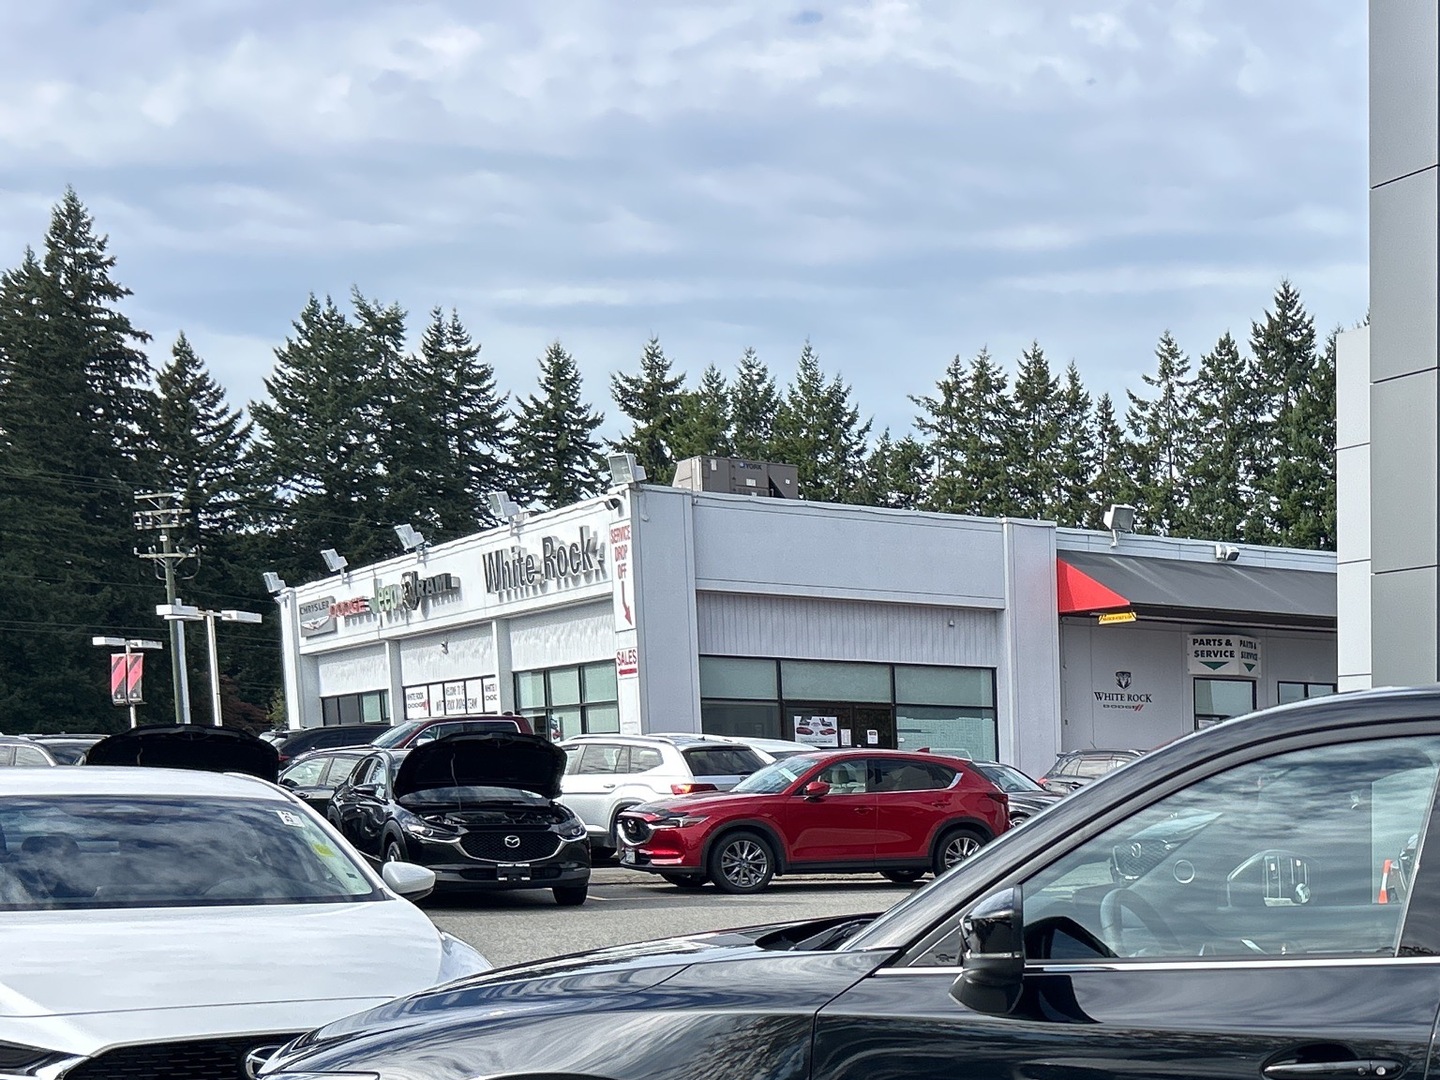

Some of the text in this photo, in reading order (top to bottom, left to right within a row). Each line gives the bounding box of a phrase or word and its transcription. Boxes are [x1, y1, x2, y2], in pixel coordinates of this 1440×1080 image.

[610, 524, 631, 545] SERVICE
[482, 525, 595, 594] White Rock
[614, 544, 628, 562] DROP
[617, 563, 627, 580] OFF
[416, 572, 452, 597] RAM
[300, 600, 330, 615] CHRYSLER
[1192, 638, 1233, 647] PARTS &
[617, 649, 637, 666] SALES
[1194, 649, 1235, 658] SERVICE
[1094, 691, 1153, 703] WHITE ROCK
